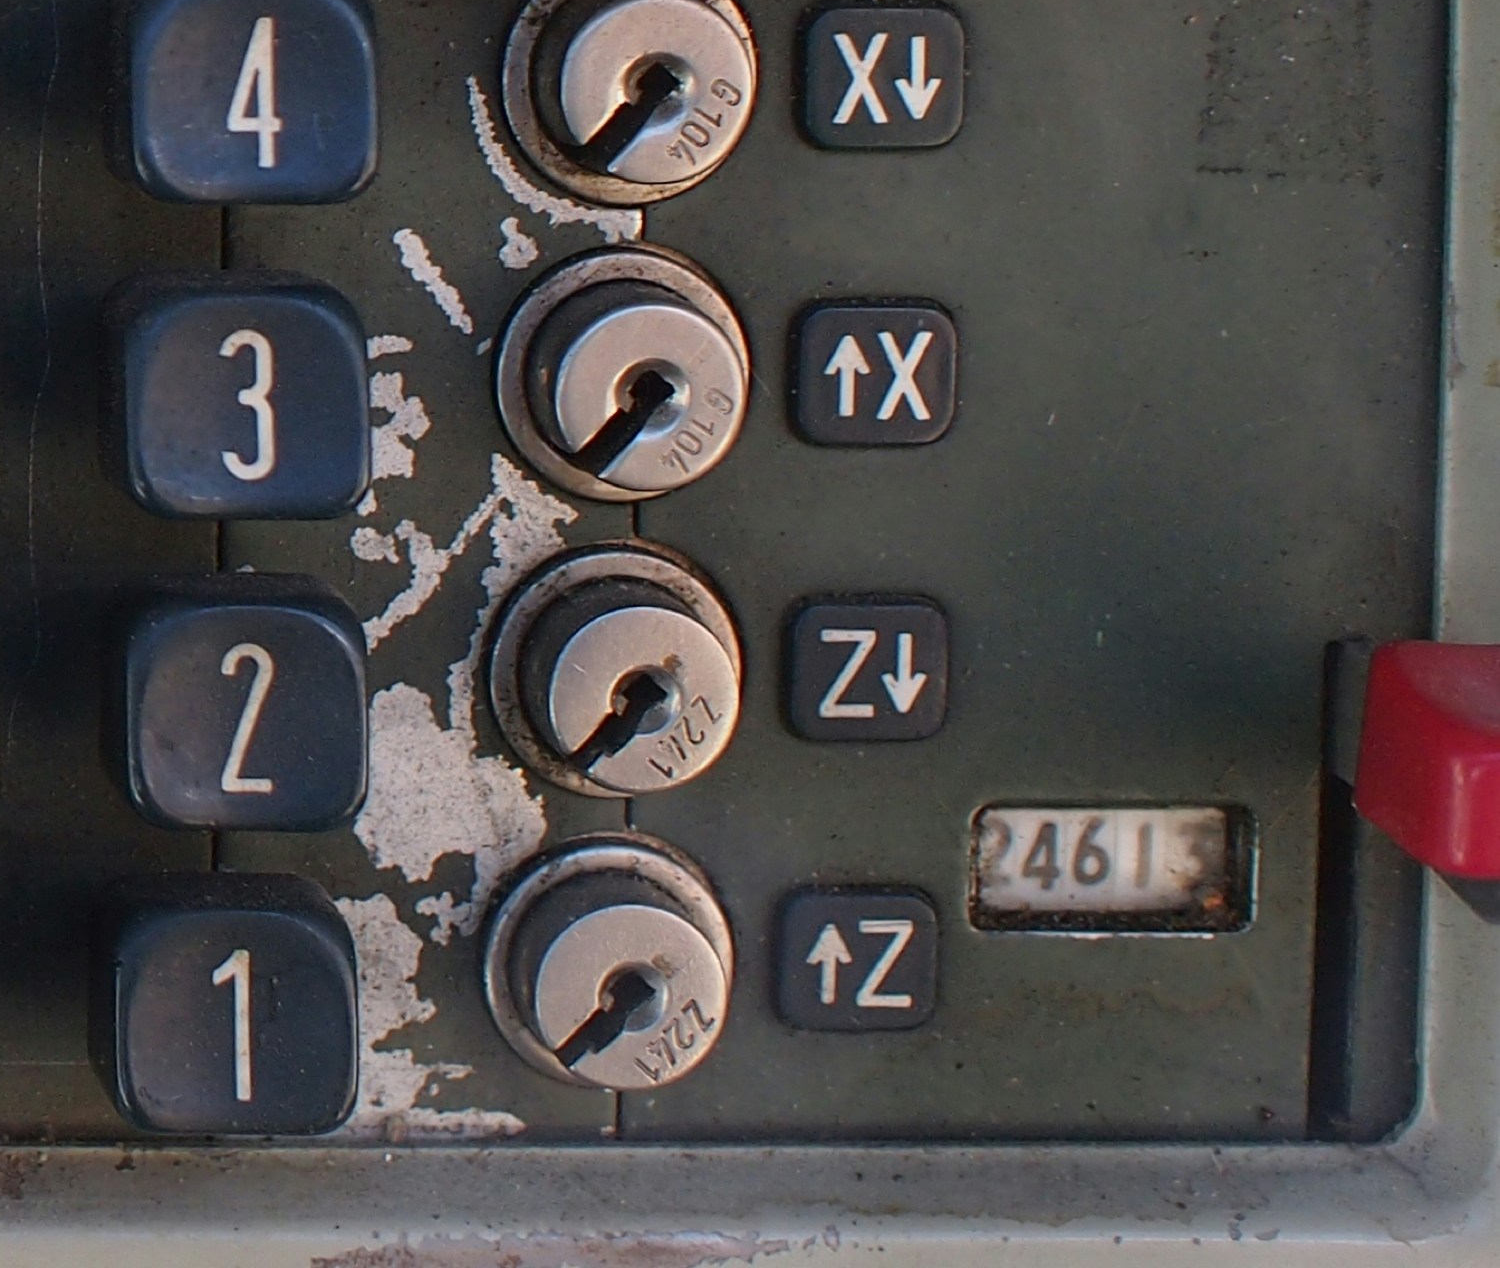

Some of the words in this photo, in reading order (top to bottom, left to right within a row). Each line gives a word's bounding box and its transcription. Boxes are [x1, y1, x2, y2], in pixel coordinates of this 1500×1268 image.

[226, 16, 283, 169] 4
[219, 329, 275, 481] 3
[220, 643, 274, 793] 2
[212, 949, 252, 1102] 1
